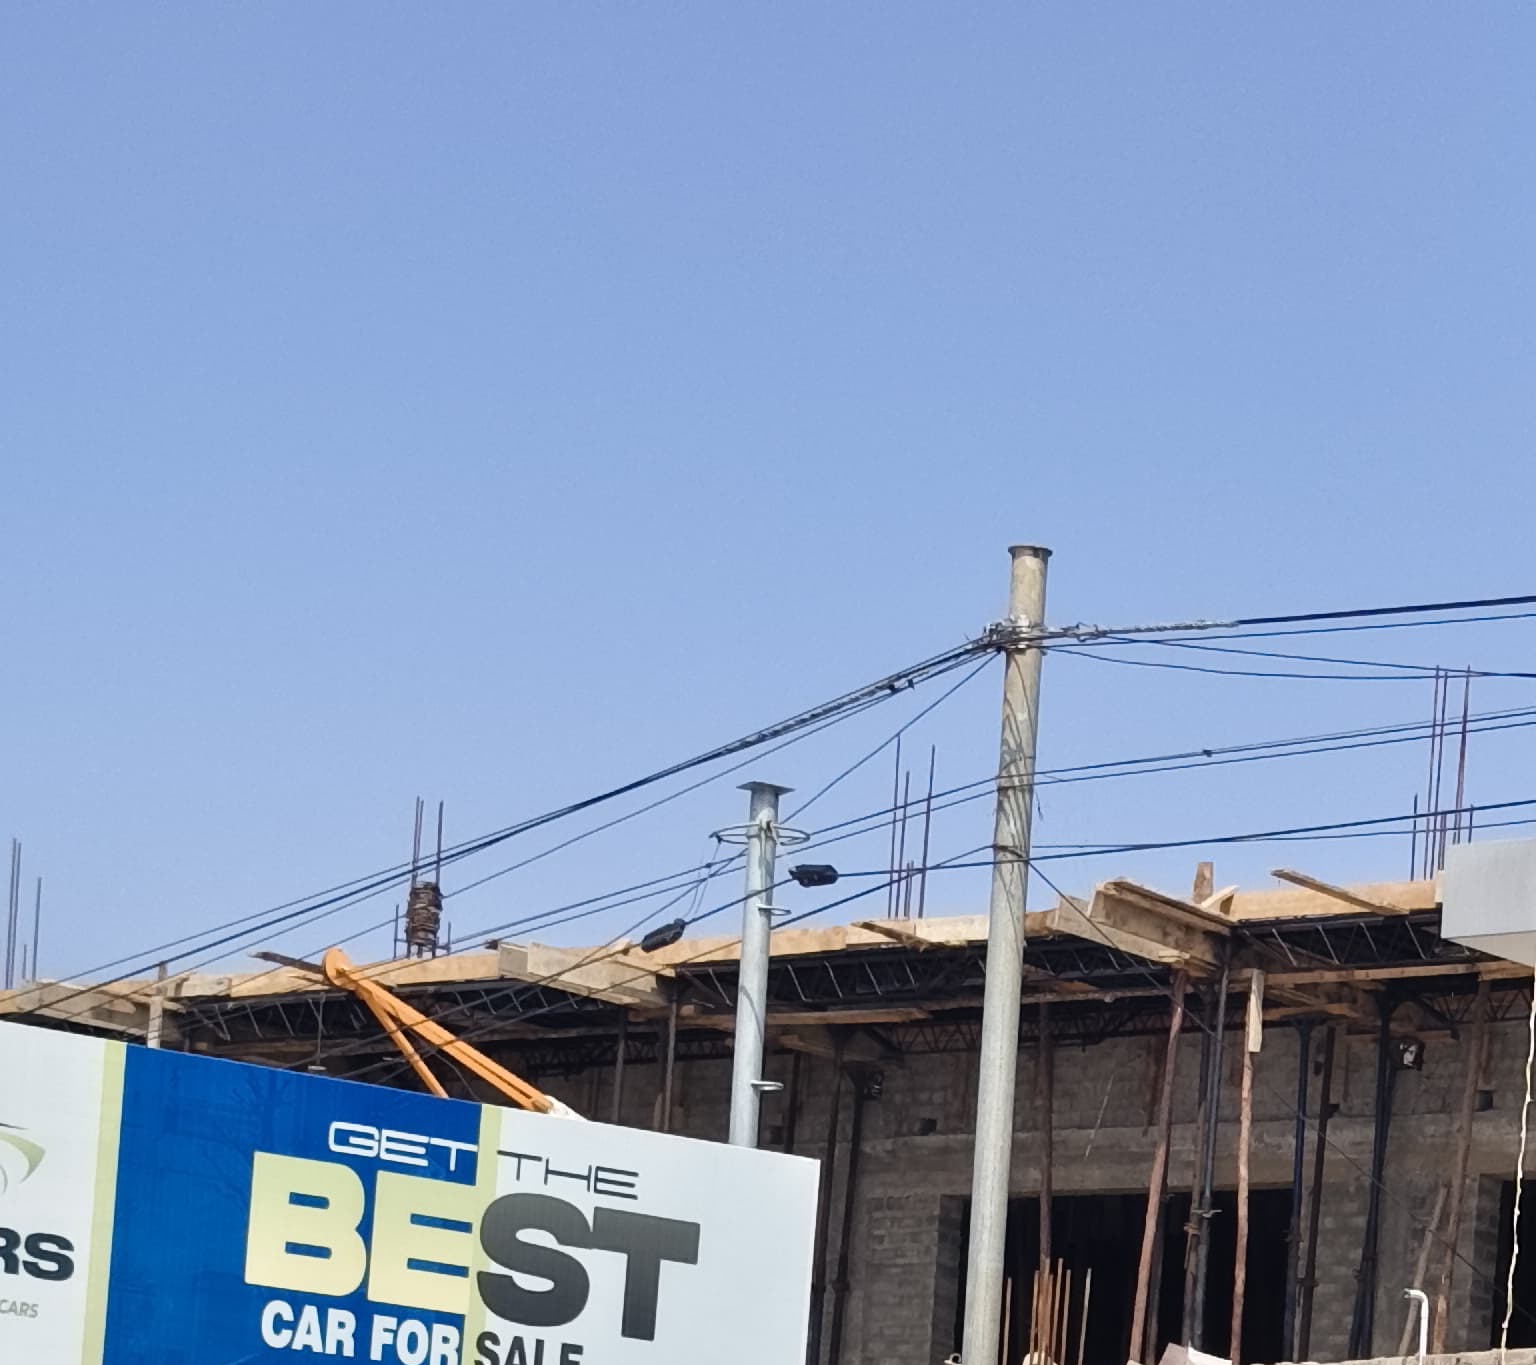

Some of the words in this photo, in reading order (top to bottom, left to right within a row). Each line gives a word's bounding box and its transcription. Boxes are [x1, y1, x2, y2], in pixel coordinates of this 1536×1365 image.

[328, 1121, 478, 1172] GET
[497, 1150, 639, 1200] THE
[244, 1151, 701, 1342] BEST
[261, 1300, 357, 1358] CAR
